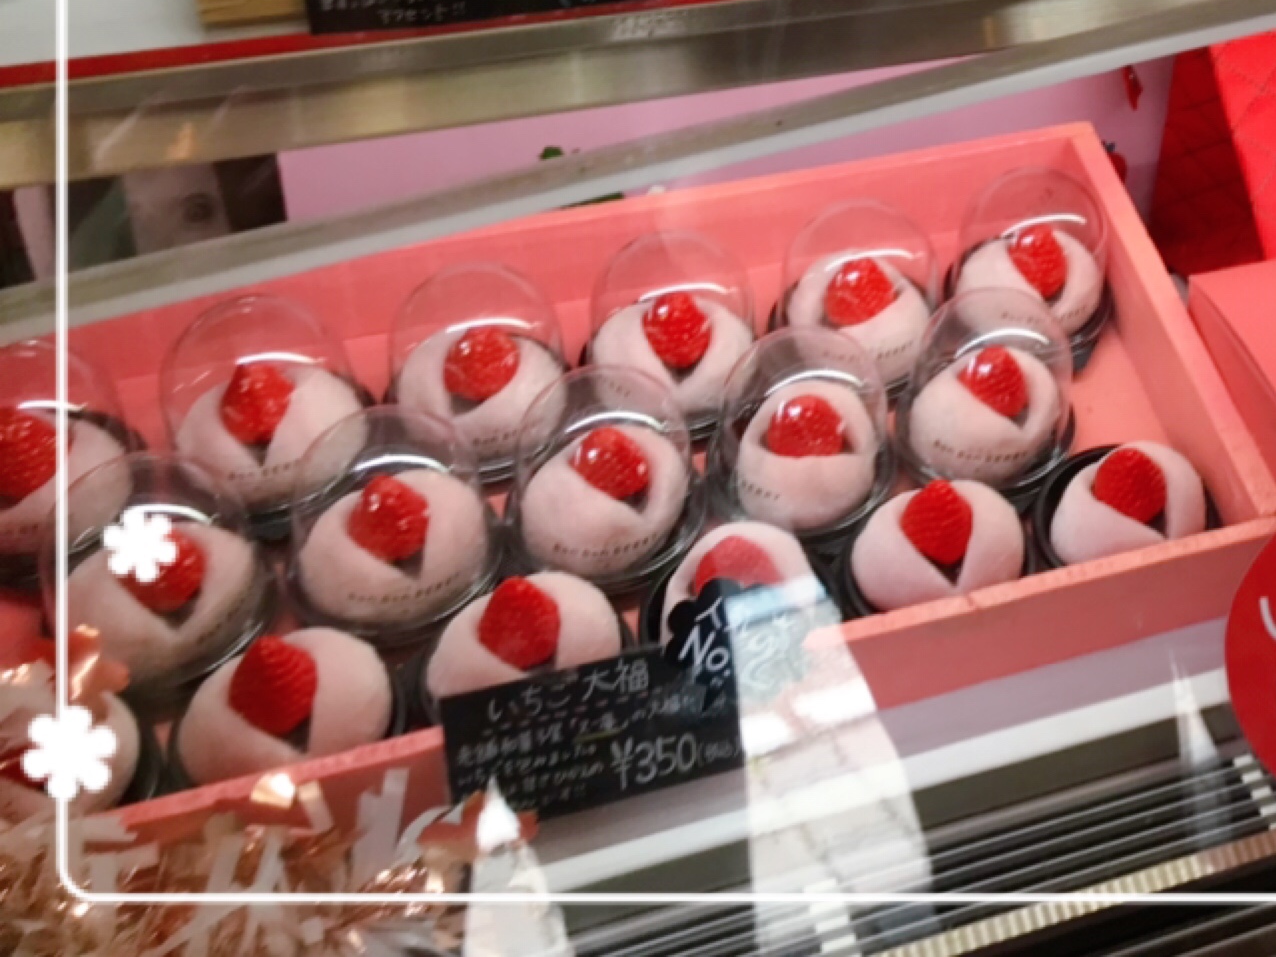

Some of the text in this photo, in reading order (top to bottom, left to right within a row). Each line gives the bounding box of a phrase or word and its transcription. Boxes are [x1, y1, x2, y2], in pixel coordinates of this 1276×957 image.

[488, 658, 650, 722] いちご大福
[610, 733, 697, 790] ¥350
